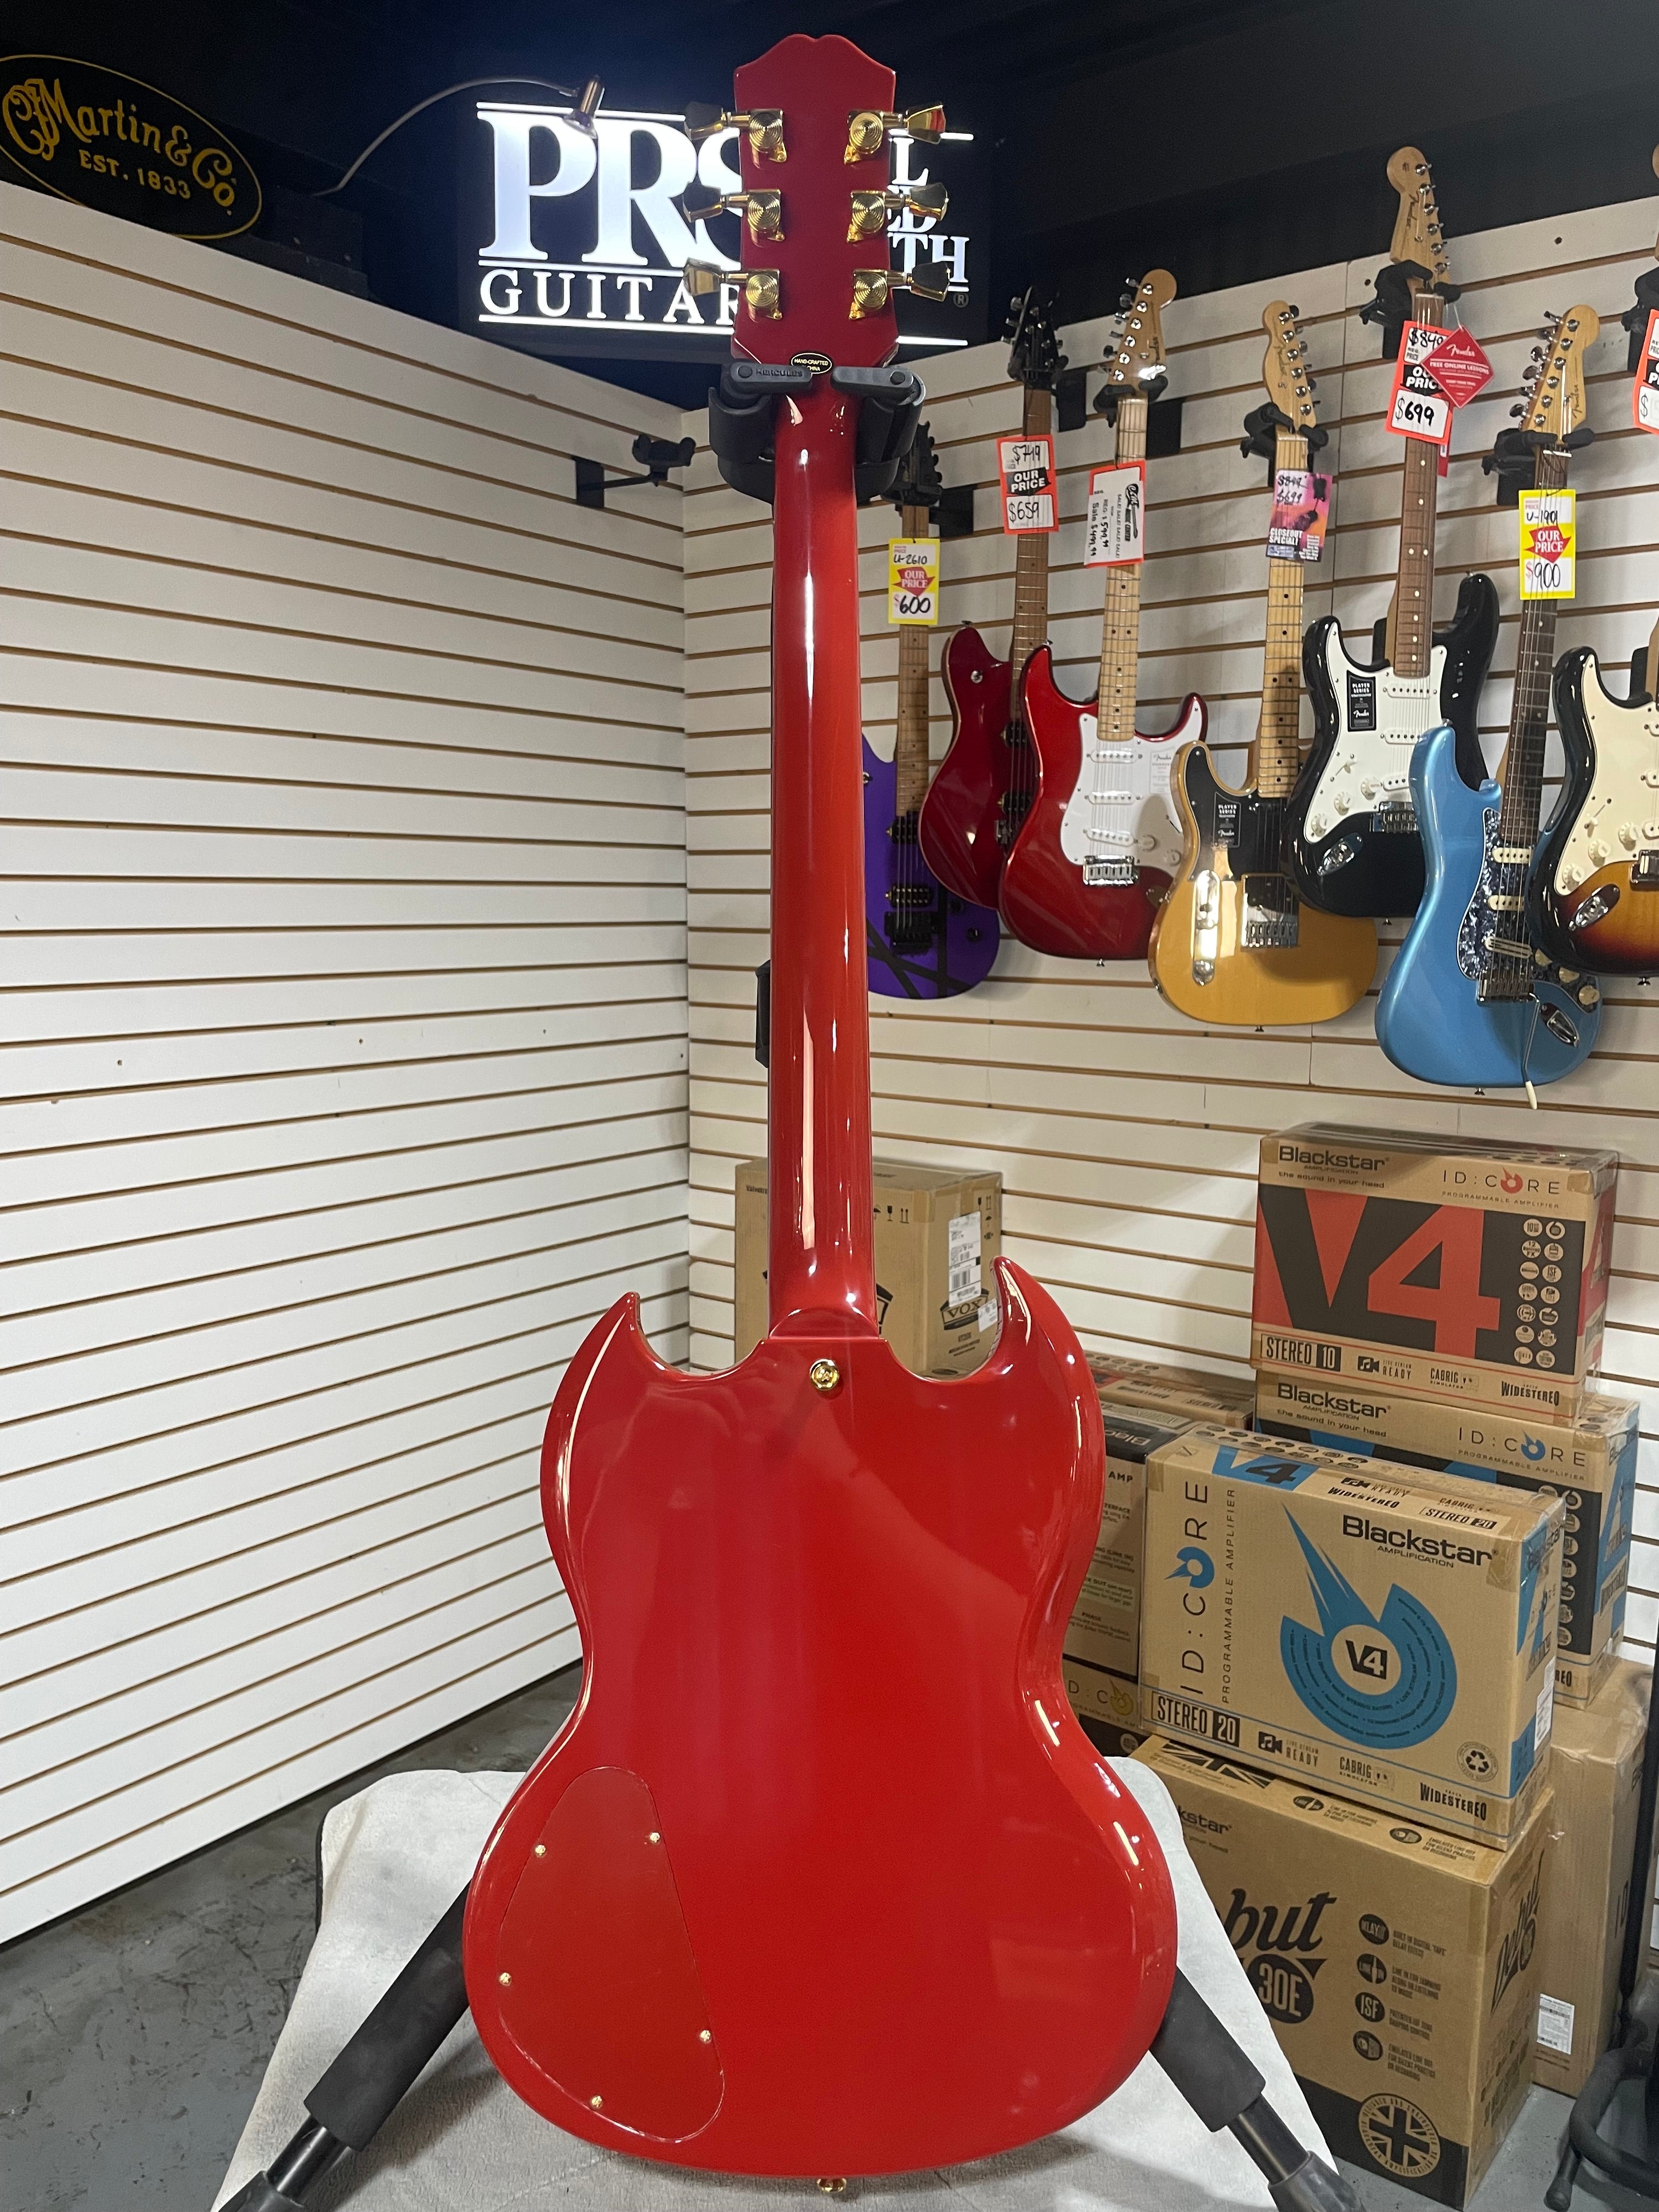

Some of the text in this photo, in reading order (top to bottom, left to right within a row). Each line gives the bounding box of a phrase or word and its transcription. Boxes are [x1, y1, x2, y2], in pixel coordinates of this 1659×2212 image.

[138, 168, 190, 199] 1833
[479, 270, 738, 325] GUITAR
[1446, 343, 1475, 357] Fender
[756, 369, 803, 377] HERCULES
[1467, 364, 1489, 375] LESSONS
[1406, 376, 1441, 390] PRIC
[1395, 396, 1435, 427] $699
[1011, 478, 1046, 493] PRICE
[1014, 470, 1039, 482] OUR
[1009, 501, 1039, 523] $659
[1270, 527, 1303, 538] CLOSEOUT
[1538, 530, 1560, 541] OUR
[1536, 539, 1564, 553] PRICE
[901, 579, 928, 588] PRICE
[904, 570, 925, 579] OUR
[1526, 562, 1561, 590] $900
[1353, 709, 1369, 718] Fender
[1218, 829, 1234, 838] Fender
[1304, 1165, 1358, 1175] AMPLIFICATION
[1442, 1191, 1559, 1209] PROGRAMMABLE AMPLIFIER
[947, 1297, 983, 1318] VOX
[1266, 1337, 1335, 1369] STEREO 10
[1383, 1365, 1412, 1380] READY
[1430, 1368, 1458, 1384] CABRIG
[1501, 1381, 1560, 1406] WIDESTEREO
[1277, 1408, 1294, 1417] the
[1296, 1414, 1324, 1425] sound
[1339, 1421, 1361, 1432] your
[1363, 1427, 1387, 1437] head
[1303, 1404, 1360, 1420] AMPLIFICATION
[1211, 1444, 1319, 1491] V4
[1458, 1450, 1585, 1481] PROGRAMMABLE AMPLIFIER
[1108, 1471, 1133, 1483] AMP
[1328, 1487, 1400, 1509] WIDESTEREO
[1425, 1509, 1493, 1530] STEREO 20
[1377, 1545, 1454, 1568] AMPLIFICATION
[1221, 1488, 1236, 1704] PROGRAMMABLE AMPLIFIER
[1345, 1639, 1387, 1680] V4
[1157, 1695, 1207, 1735] STEREO
[1217, 1715, 1235, 1744] 20
[1286, 1747, 1318, 1768] READY
[1339, 1757, 1372, 1779] CABRIG
[1420, 1782, 1487, 1821] WIDESTEREO
[1178, 1804, 1229, 1835] kstar
[1223, 1888, 1338, 1953] but
[1257, 1962, 1304, 2017] 30E
[1361, 1994, 1379, 2019] ISF
